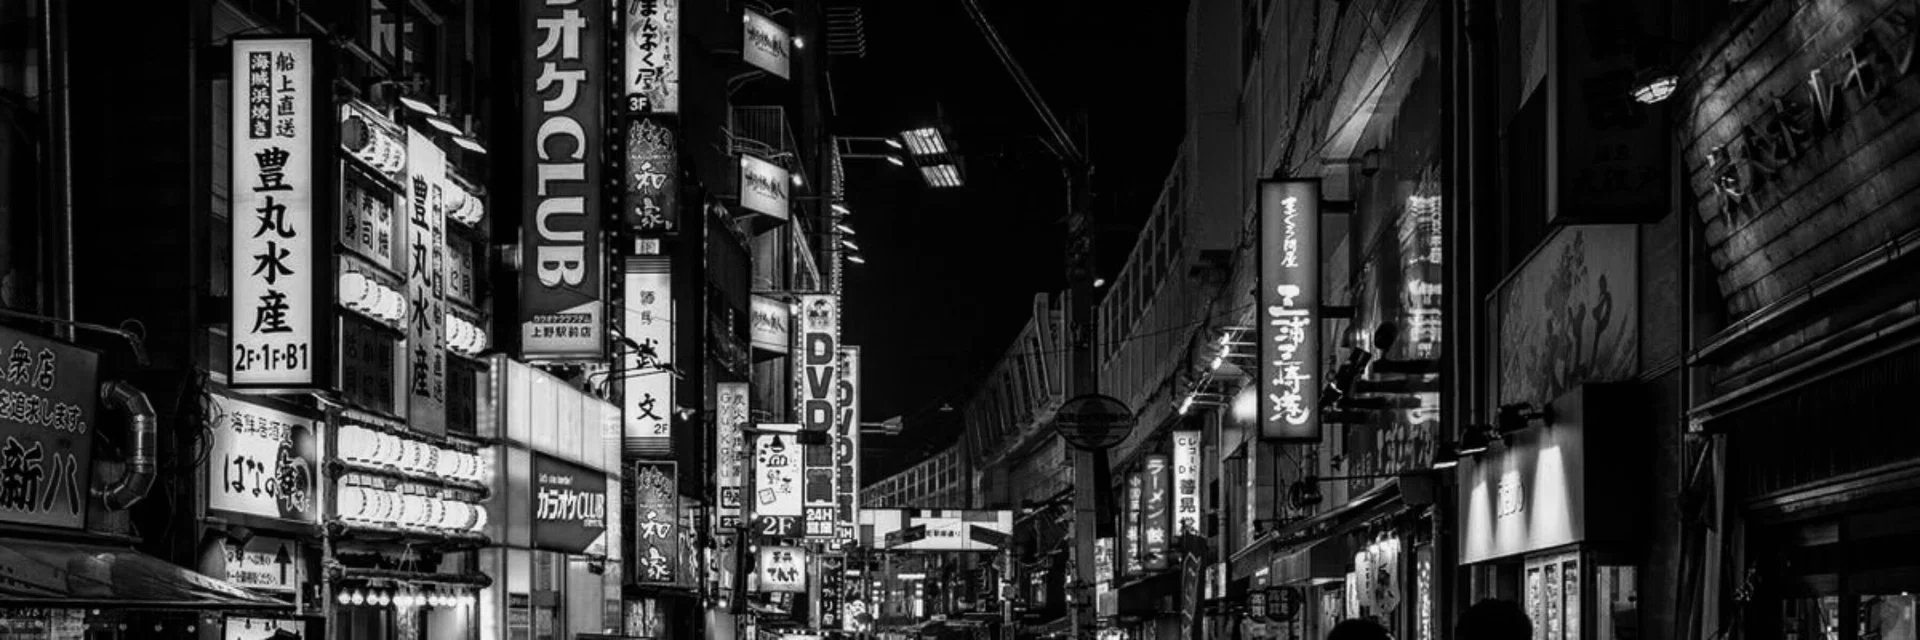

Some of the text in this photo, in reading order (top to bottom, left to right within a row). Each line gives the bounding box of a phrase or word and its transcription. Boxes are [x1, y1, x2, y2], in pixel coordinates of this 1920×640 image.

[275, 51, 296, 138] 船上直送
[629, 97, 648, 111] 3F
[536, 0, 588, 287] オケCLUB
[634, 161, 667, 229] 和家
[251, 147, 297, 334] 豊丸水産
[411, 174, 431, 398] 豊丸水産
[531, 326, 591, 338] 上野駅前店
[637, 338, 663, 421] 武文
[653, 423, 669, 435] 2F
[0, 435, 81, 516] 新八
[537, 486, 605, 520] カラオケCLUB
[640, 511, 671, 580] 和家
[762, 516, 795, 536] 2F
[806, 508, 833, 521] 24H
[767, 567, 799, 582] てんや
